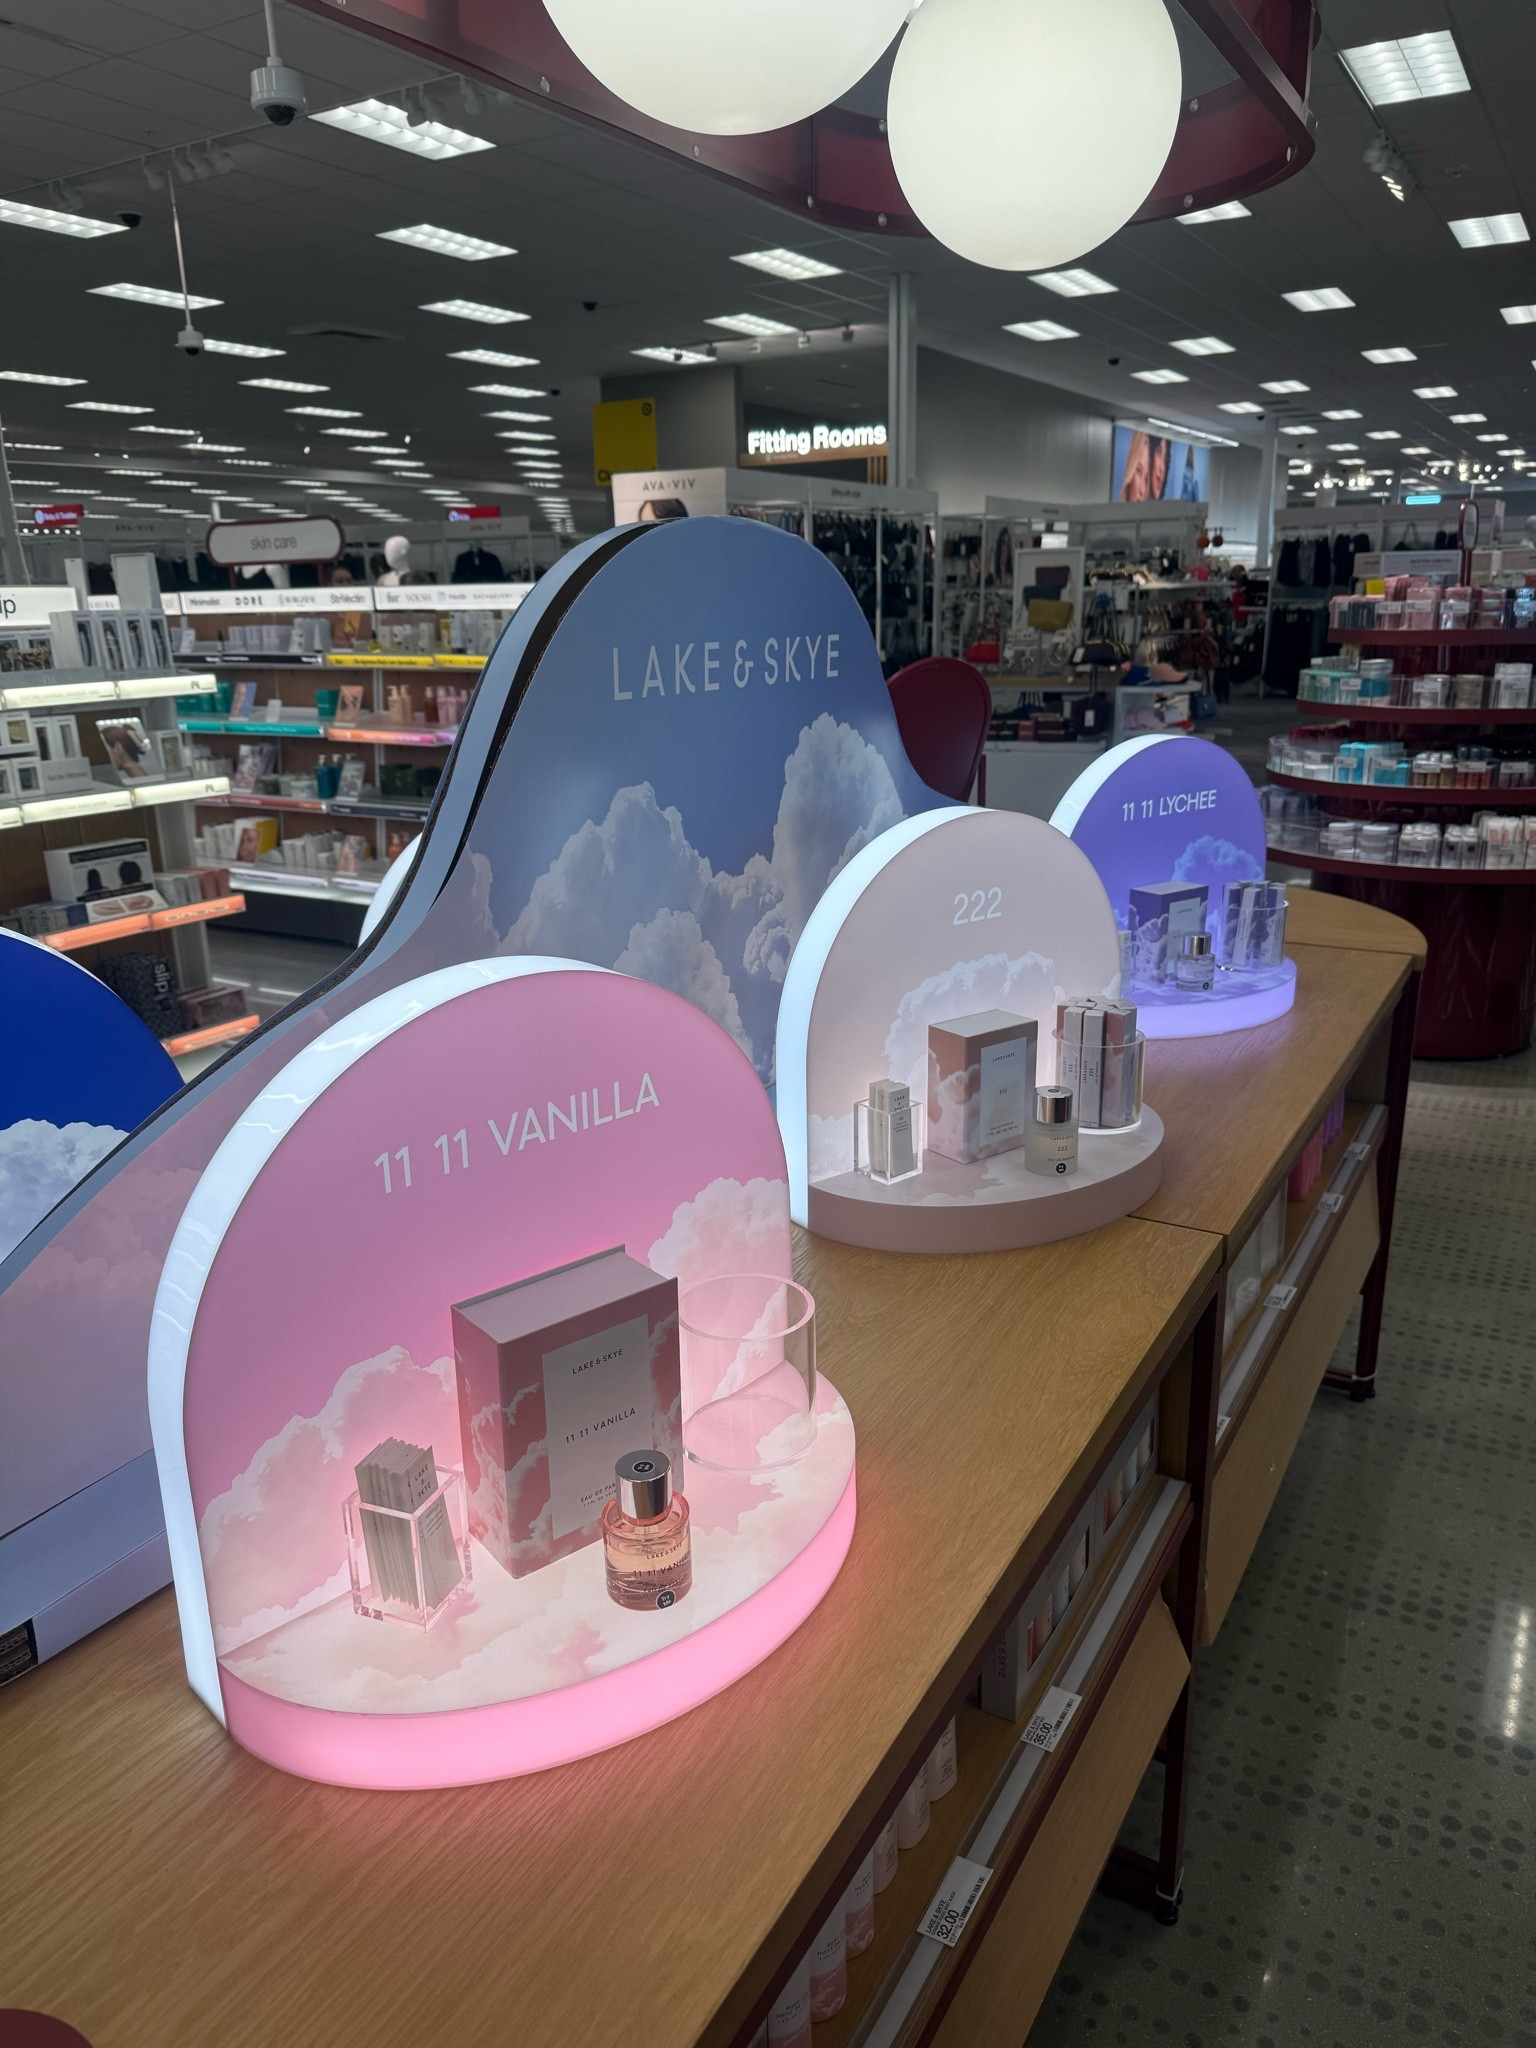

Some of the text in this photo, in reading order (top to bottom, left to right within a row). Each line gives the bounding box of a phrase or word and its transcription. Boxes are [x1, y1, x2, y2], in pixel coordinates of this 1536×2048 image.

[748, 424, 887, 455] Fitting Rooms
[641, 478, 697, 492] AVA VIV
[250, 534, 298, 551] skin care
[612, 633, 841, 701] LAKE & SKYE
[1122, 789, 1217, 822] 11 11 LYCHEE
[952, 887, 1003, 926] 222
[154, 963, 169, 993] slip
[374, 1072, 661, 1195] 11 11 VANILLA
[572, 1360, 595, 1375] LAKE
[602, 1348, 623, 1362] SKYE
[565, 1407, 636, 1444] 11 11 VANILLA
[414, 1463, 429, 1482] LAKE
[417, 1481, 432, 1499] SKYE
[1033, 1722, 1053, 1745] 35.00
[925, 1917, 936, 1934] LAKE
[935, 1898, 947, 1914] SKYE
[936, 1909, 960, 1940] 32.00
